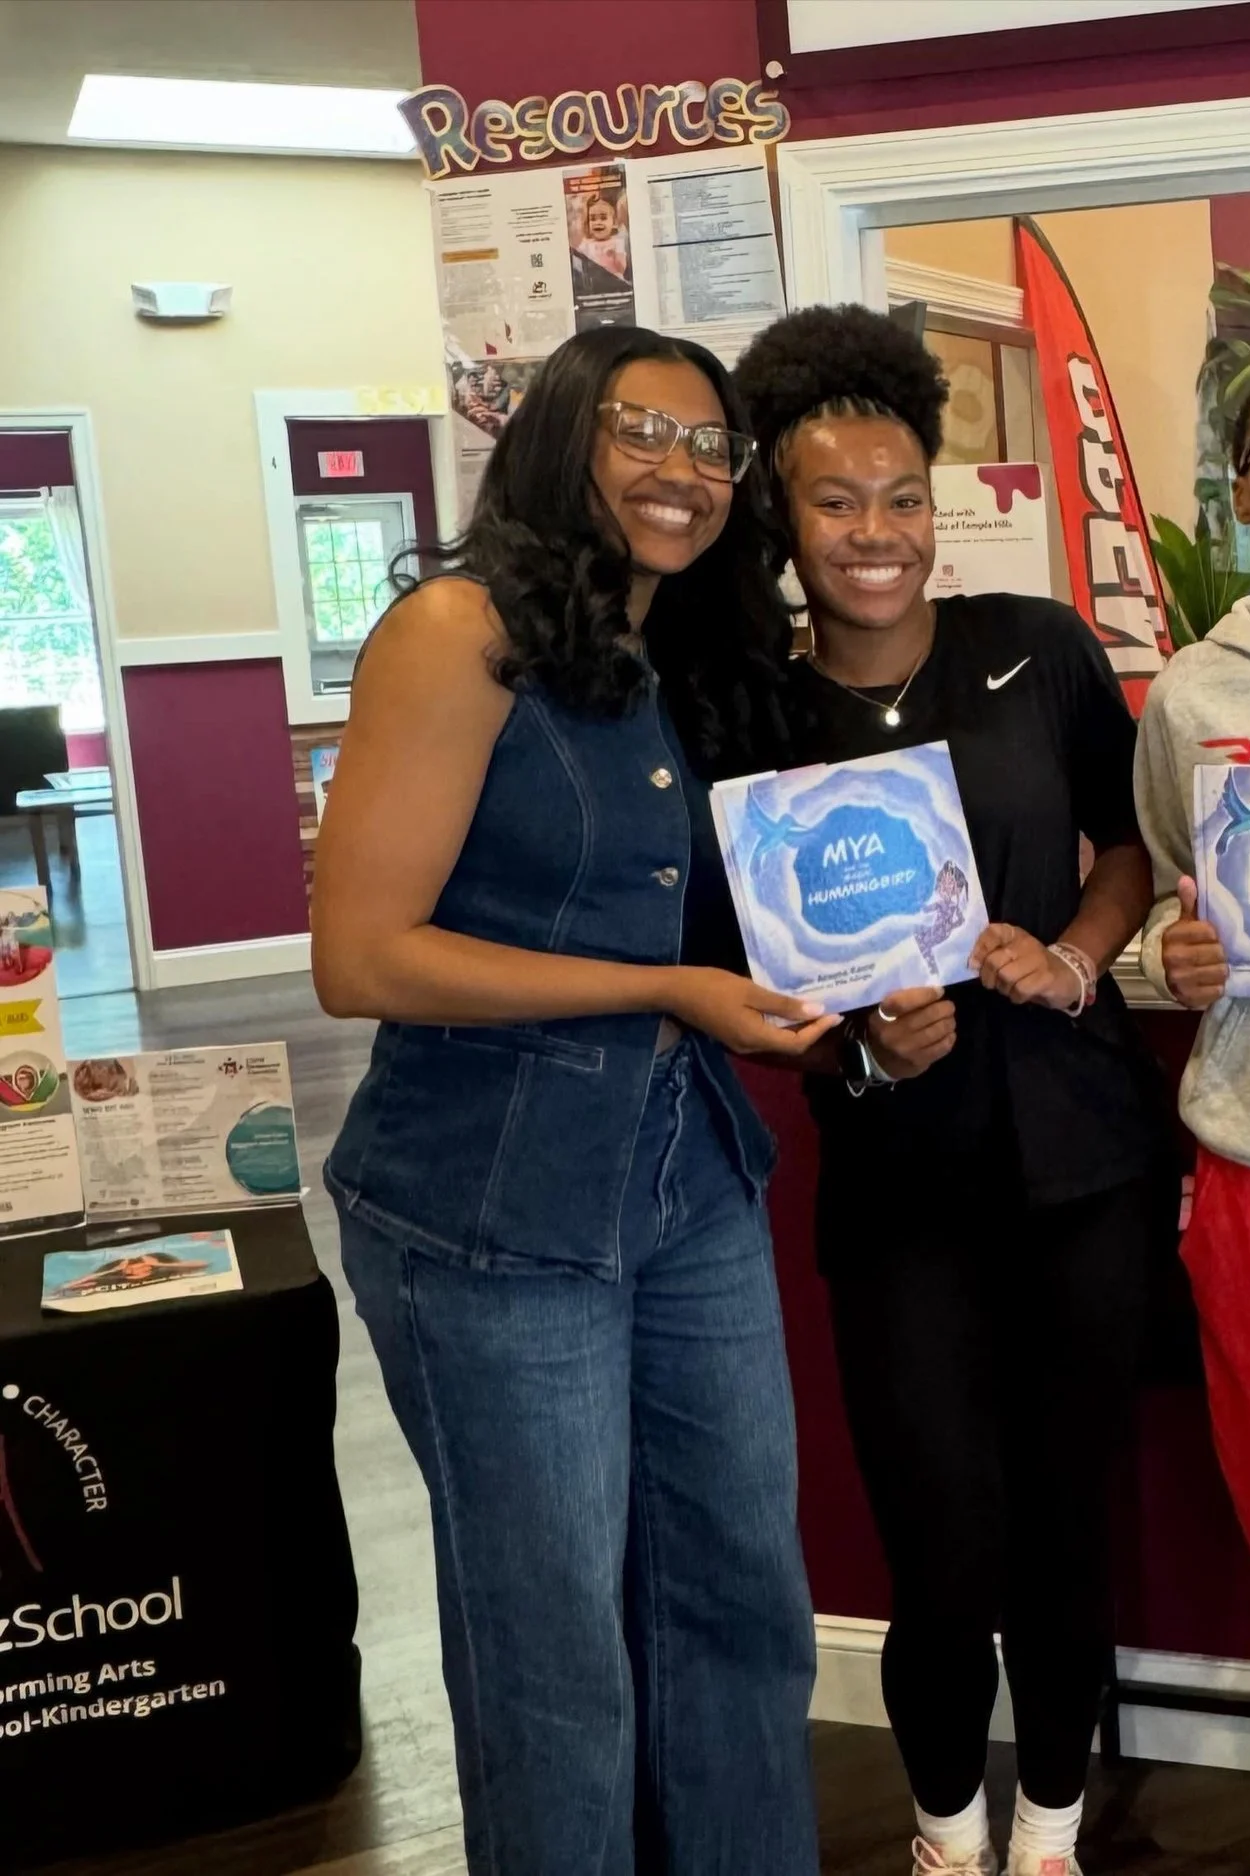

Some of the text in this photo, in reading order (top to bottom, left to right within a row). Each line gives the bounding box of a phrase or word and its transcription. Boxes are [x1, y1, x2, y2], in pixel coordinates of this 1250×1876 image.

[398, 77, 791, 180] Resources
[823, 832, 886, 868] MYA
[808, 869, 916, 906] HUMMINGBIRD
[23, 1395, 107, 1513] CHARACTER
[0, 1660, 156, 1706] rming Arts
[0, 1679, 226, 1739] ol-Kindergarten
